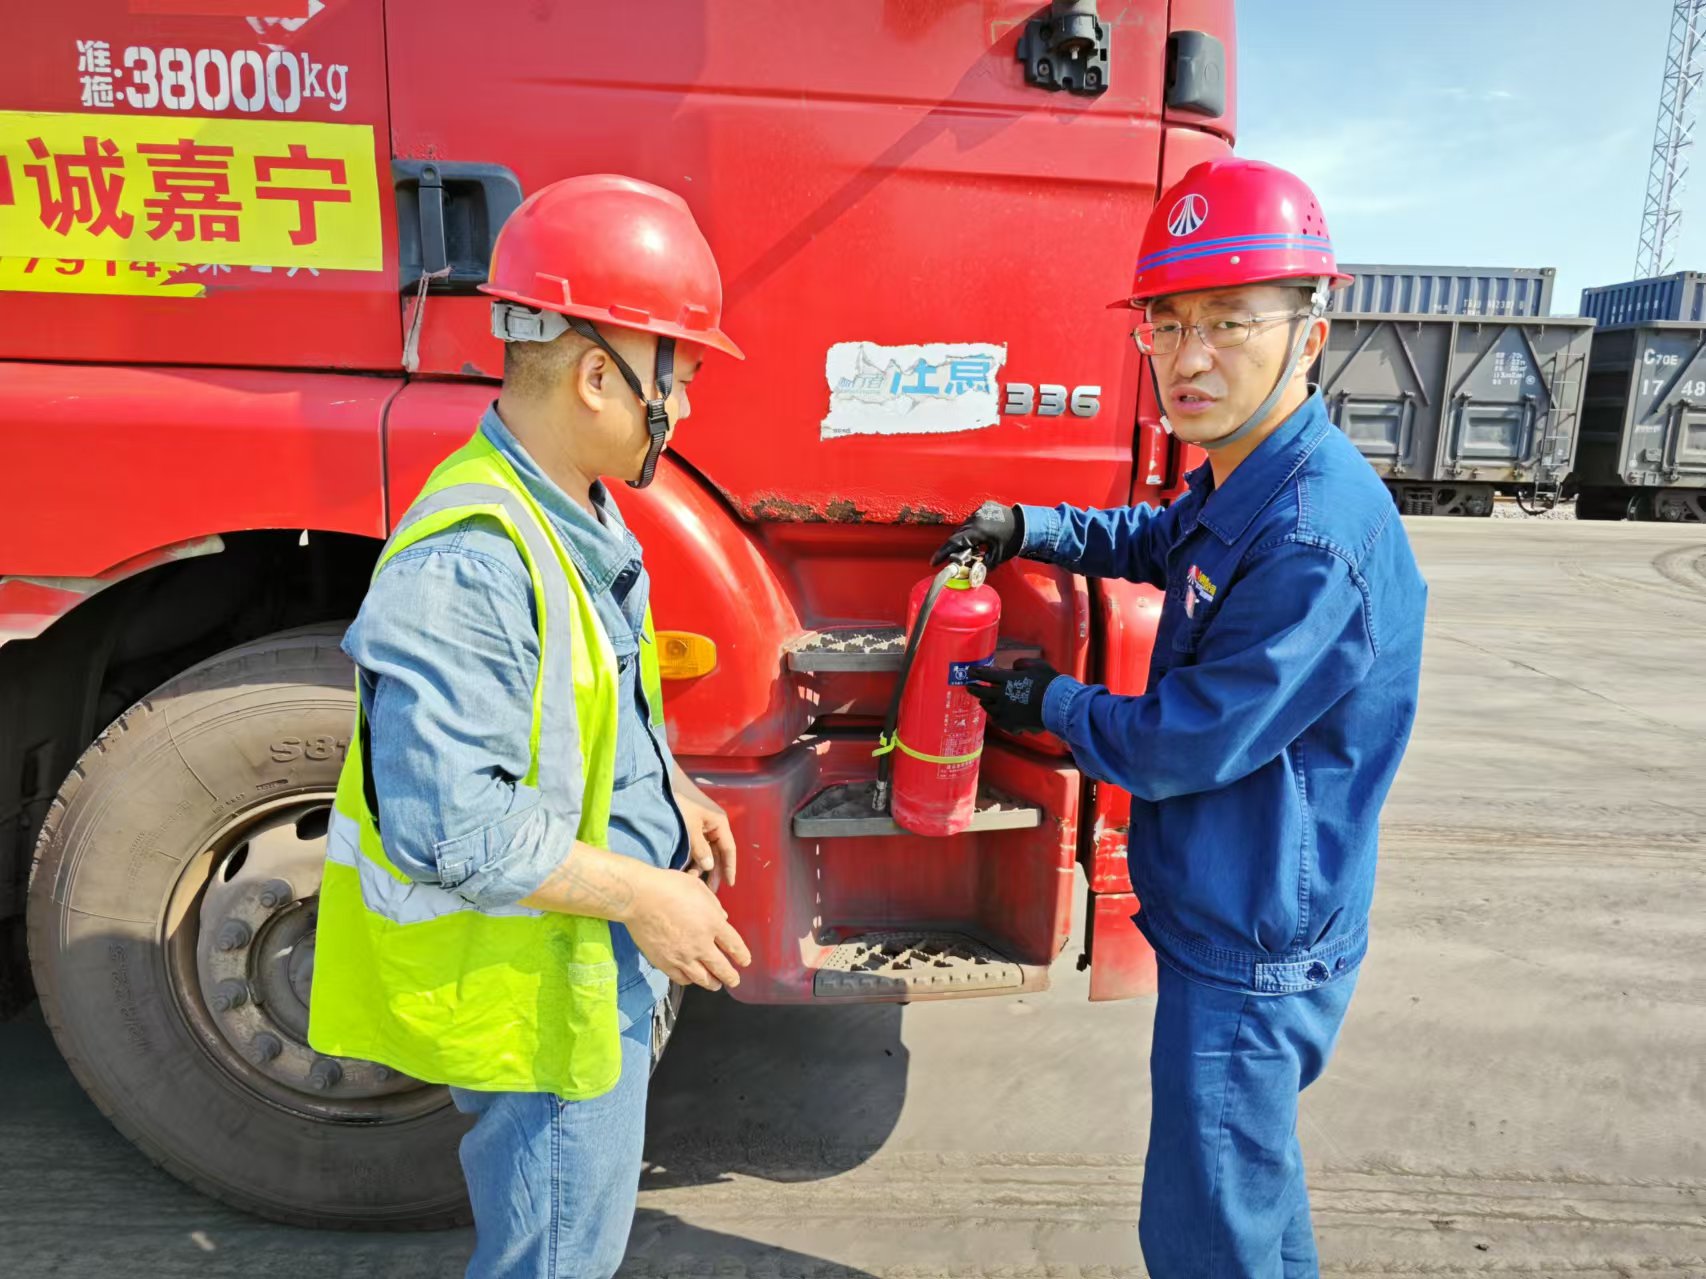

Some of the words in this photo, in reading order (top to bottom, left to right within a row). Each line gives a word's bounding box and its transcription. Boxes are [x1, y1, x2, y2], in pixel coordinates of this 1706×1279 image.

[0, 136, 352, 246] 诚嘉宁
[1004, 382, 1102, 418] 336
